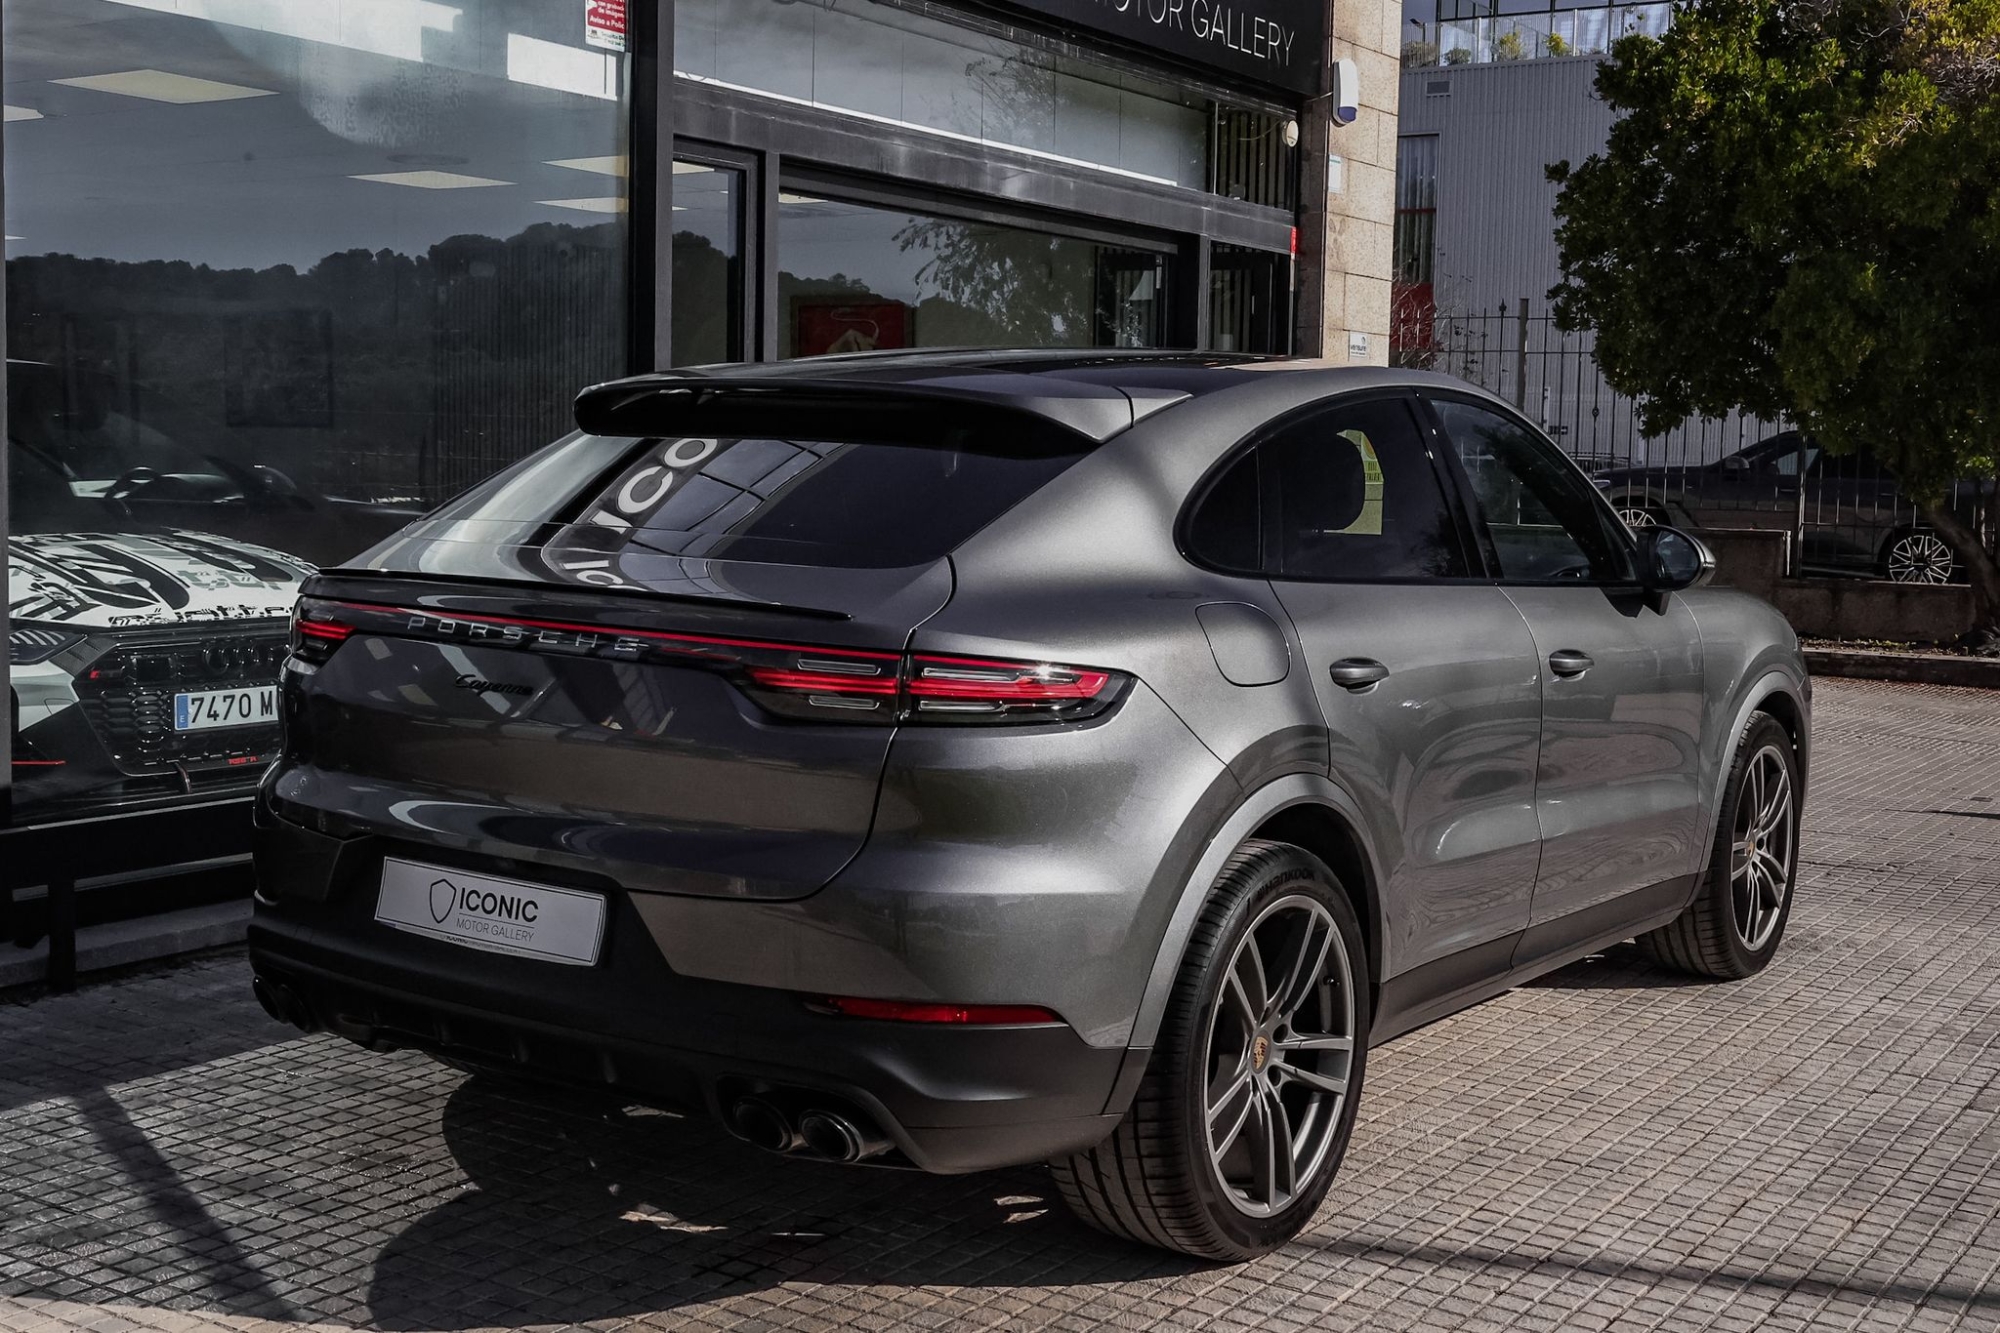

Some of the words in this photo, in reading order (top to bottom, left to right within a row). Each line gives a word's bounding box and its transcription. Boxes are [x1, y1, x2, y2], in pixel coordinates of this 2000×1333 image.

[589, 15, 606, 25] Aviso
[1191, 0, 1295, 66] GALLERY
[407, 616, 641, 651] PORSCHE
[455, 674, 535, 697] Cayenne
[191, 693, 251, 723] 7470
[459, 887, 539, 923] ICONIC
[456, 917, 490, 935] MOTOR
[491, 924, 536, 942] GALLERY
